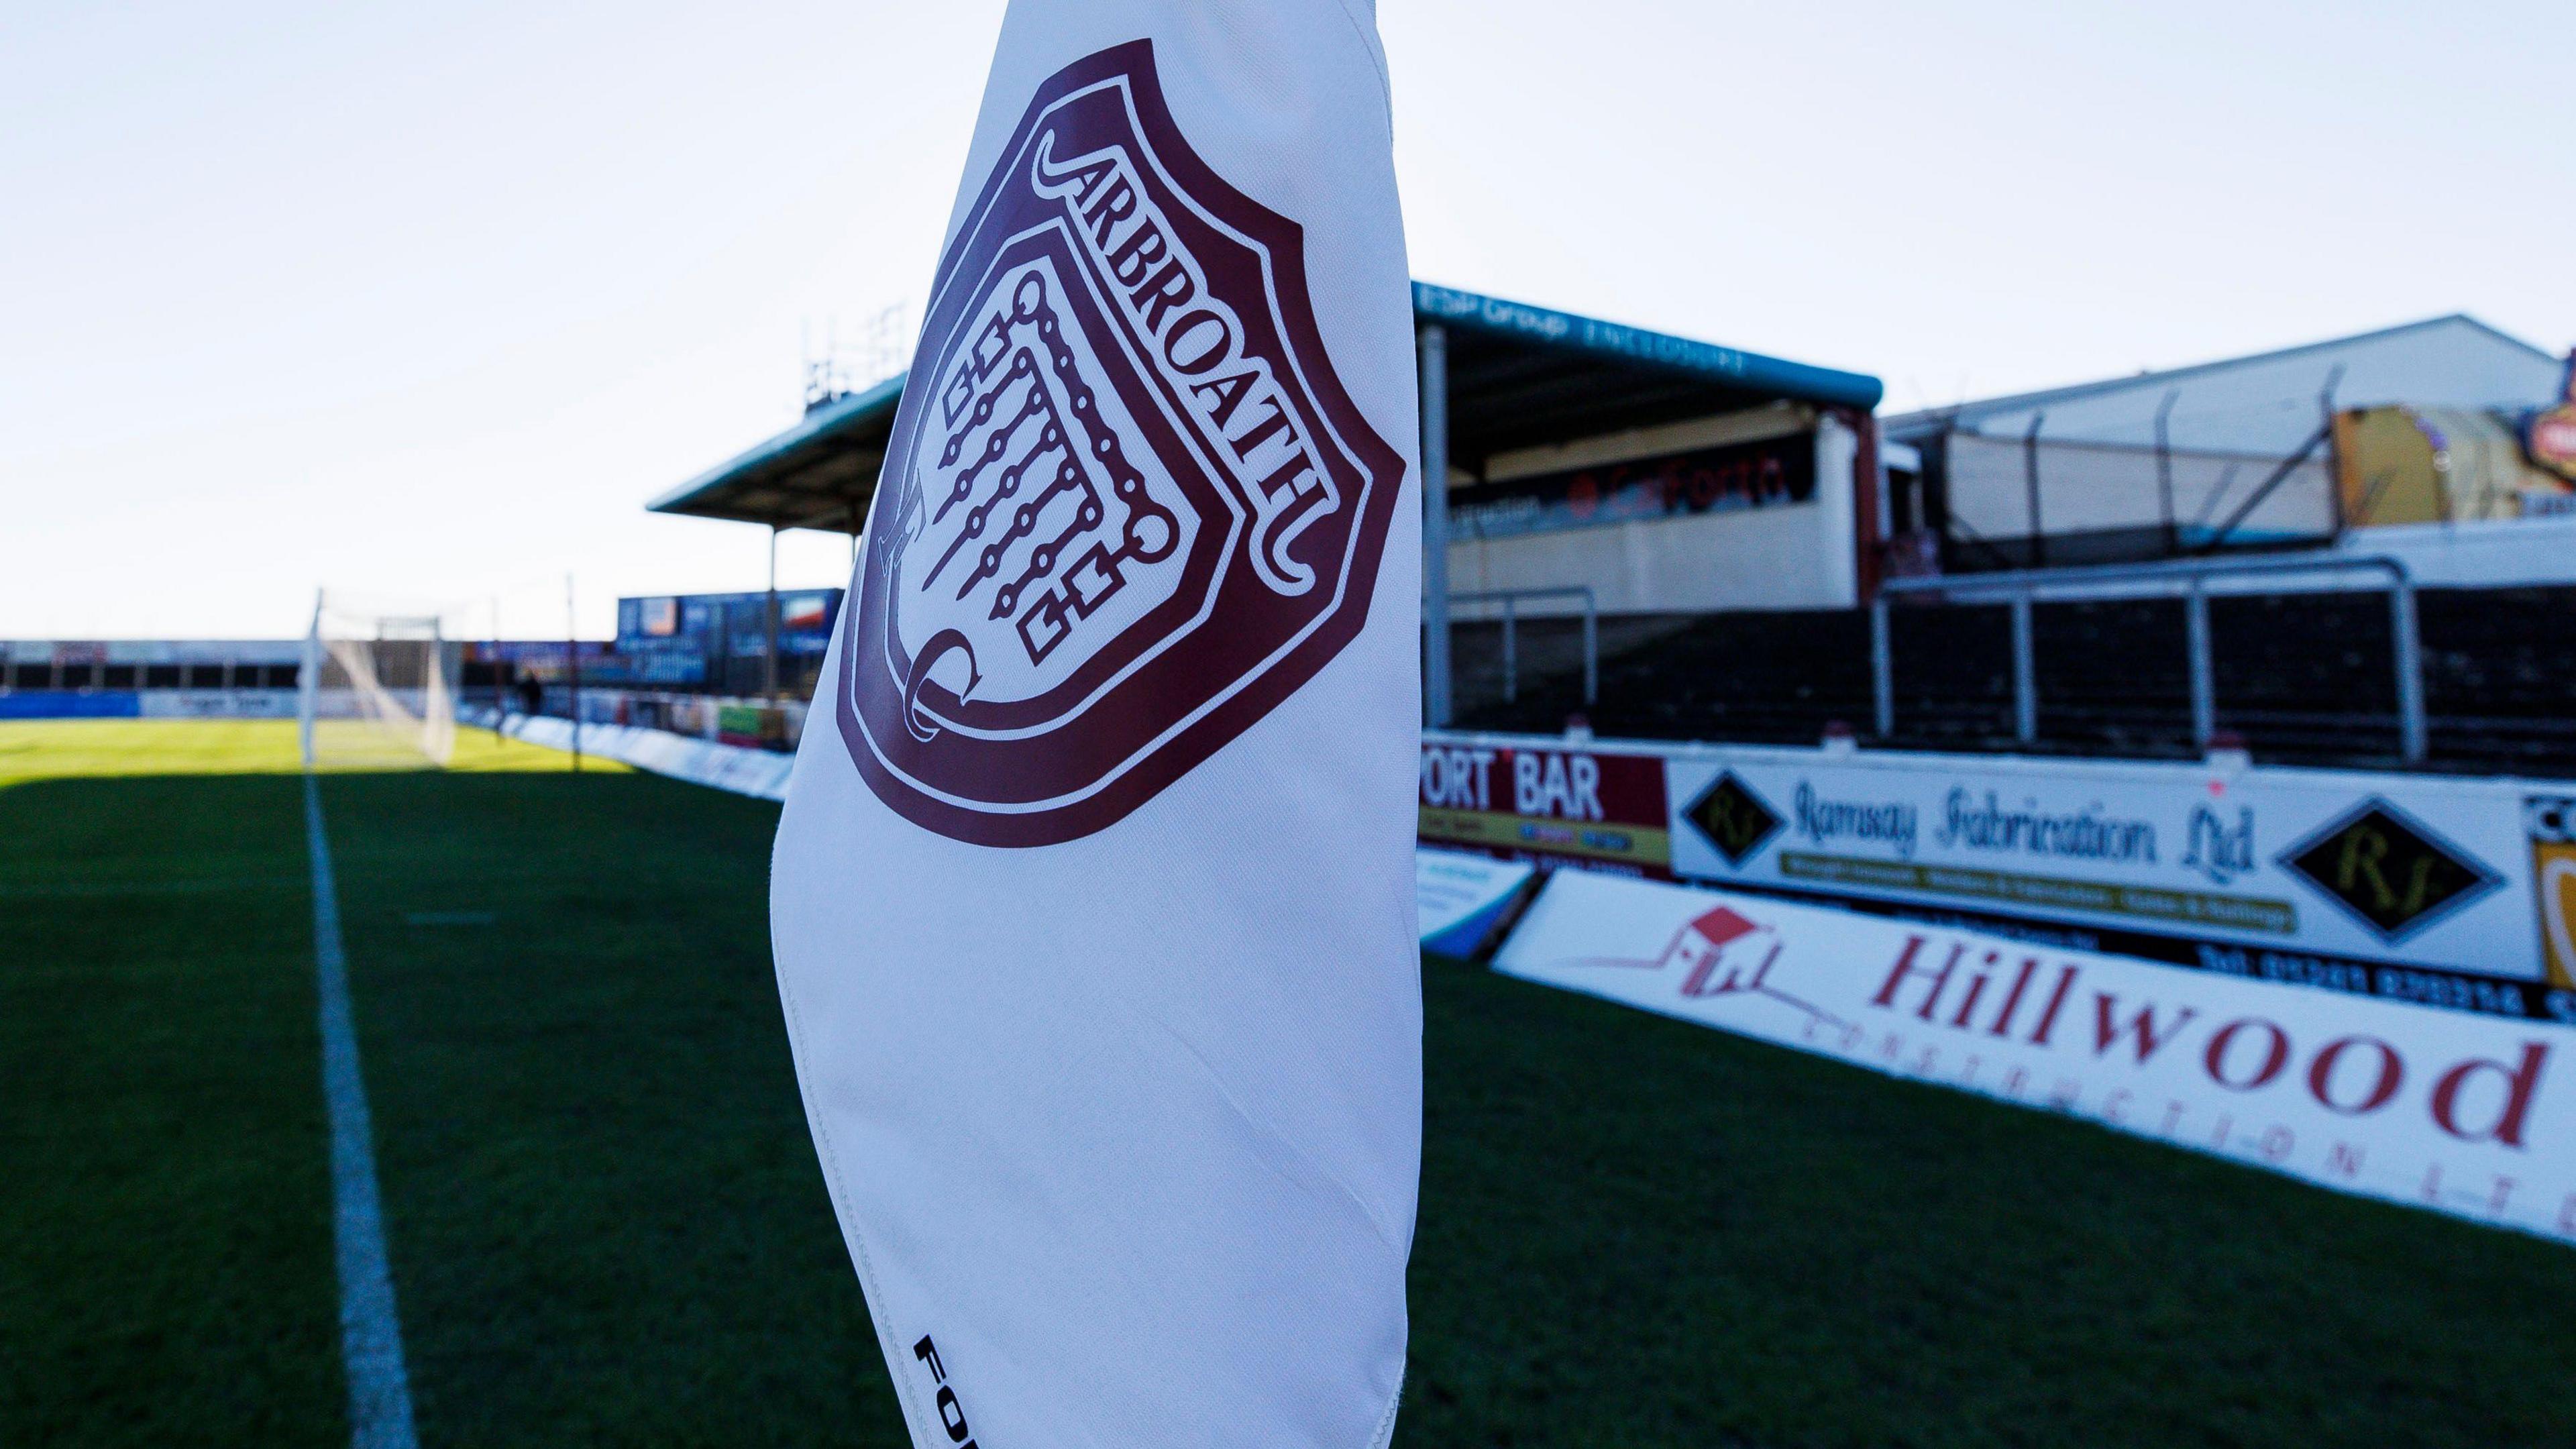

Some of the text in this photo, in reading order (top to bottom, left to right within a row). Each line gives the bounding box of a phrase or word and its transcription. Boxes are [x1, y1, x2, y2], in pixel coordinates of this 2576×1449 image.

[1036, 138, 1332, 584] ARBROATH
[1483, 298, 1570, 339] Group
[1420, 748, 1605, 822] ORT BAR
[1795, 781, 1919, 860] Ramsay
[1933, 785, 2159, 865] Fabrication
[1802, 1012, 2368, 1181] CONSTRUCTION
[1870, 932, 2553, 1148] Hillwood
[913, 1334, 979, 1449] FO
